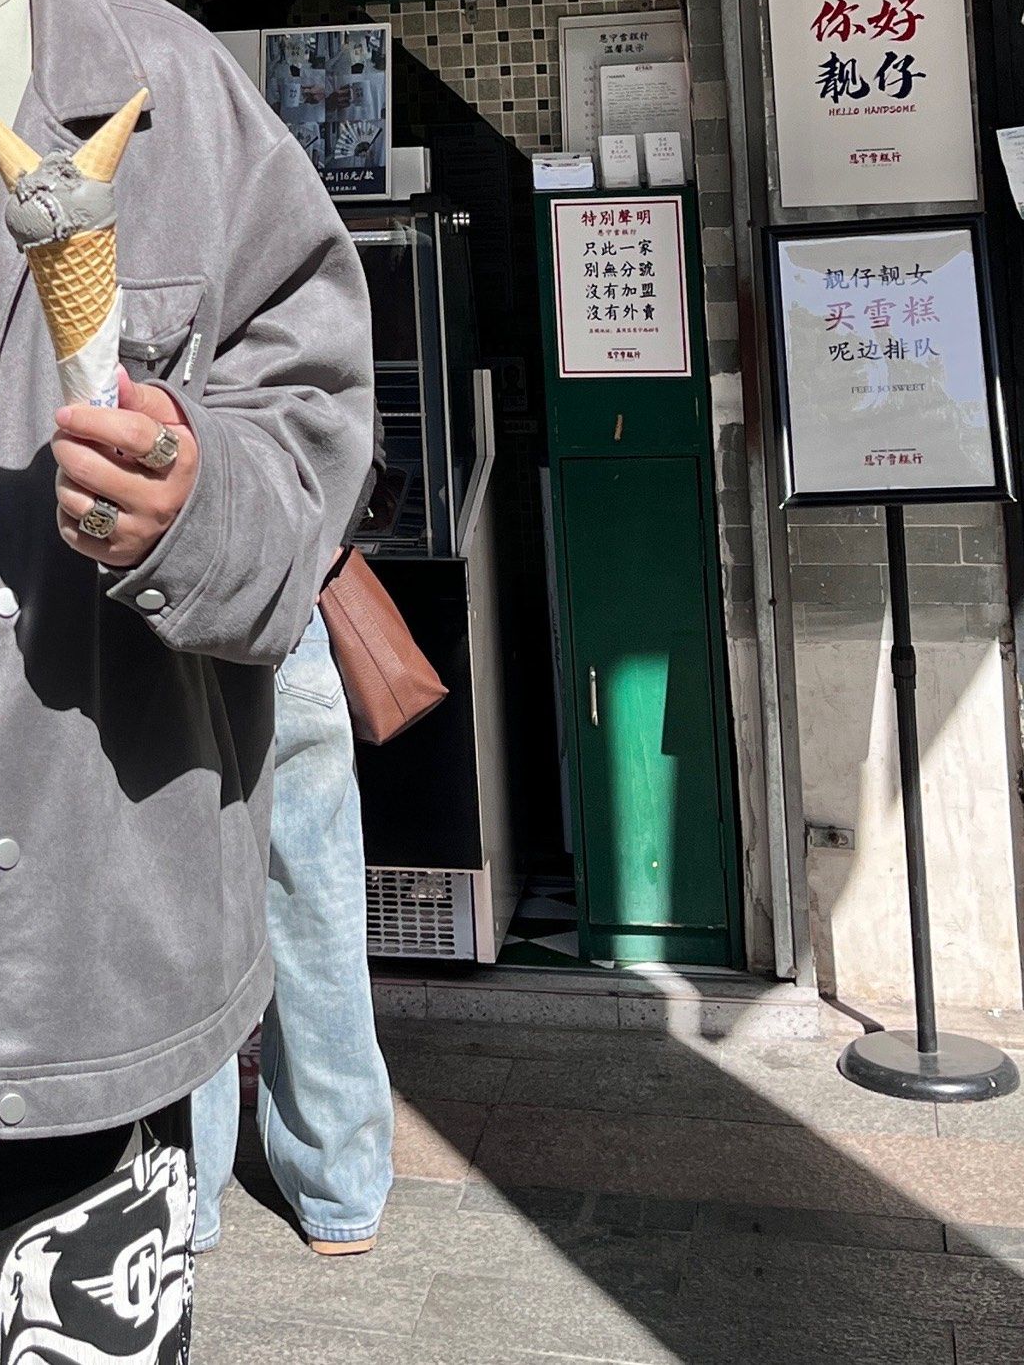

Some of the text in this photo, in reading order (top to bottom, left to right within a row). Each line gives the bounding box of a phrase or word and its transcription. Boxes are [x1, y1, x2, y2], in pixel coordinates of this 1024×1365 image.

[814, 51, 927, 104] 靓仔
[828, 104, 917, 116] HELLO HANDSOME
[849, 151, 902, 164] 恩宁雪糕行
[583, 239, 653, 256] 只此一家
[823, 263, 933, 290] 靓仔靓女
[824, 295, 941, 331] 买雪糕
[829, 337, 940, 362] 呢边排队
[892, 383, 925, 392] SWEET
[864, 453, 923, 466] 恩宁雪糕行
